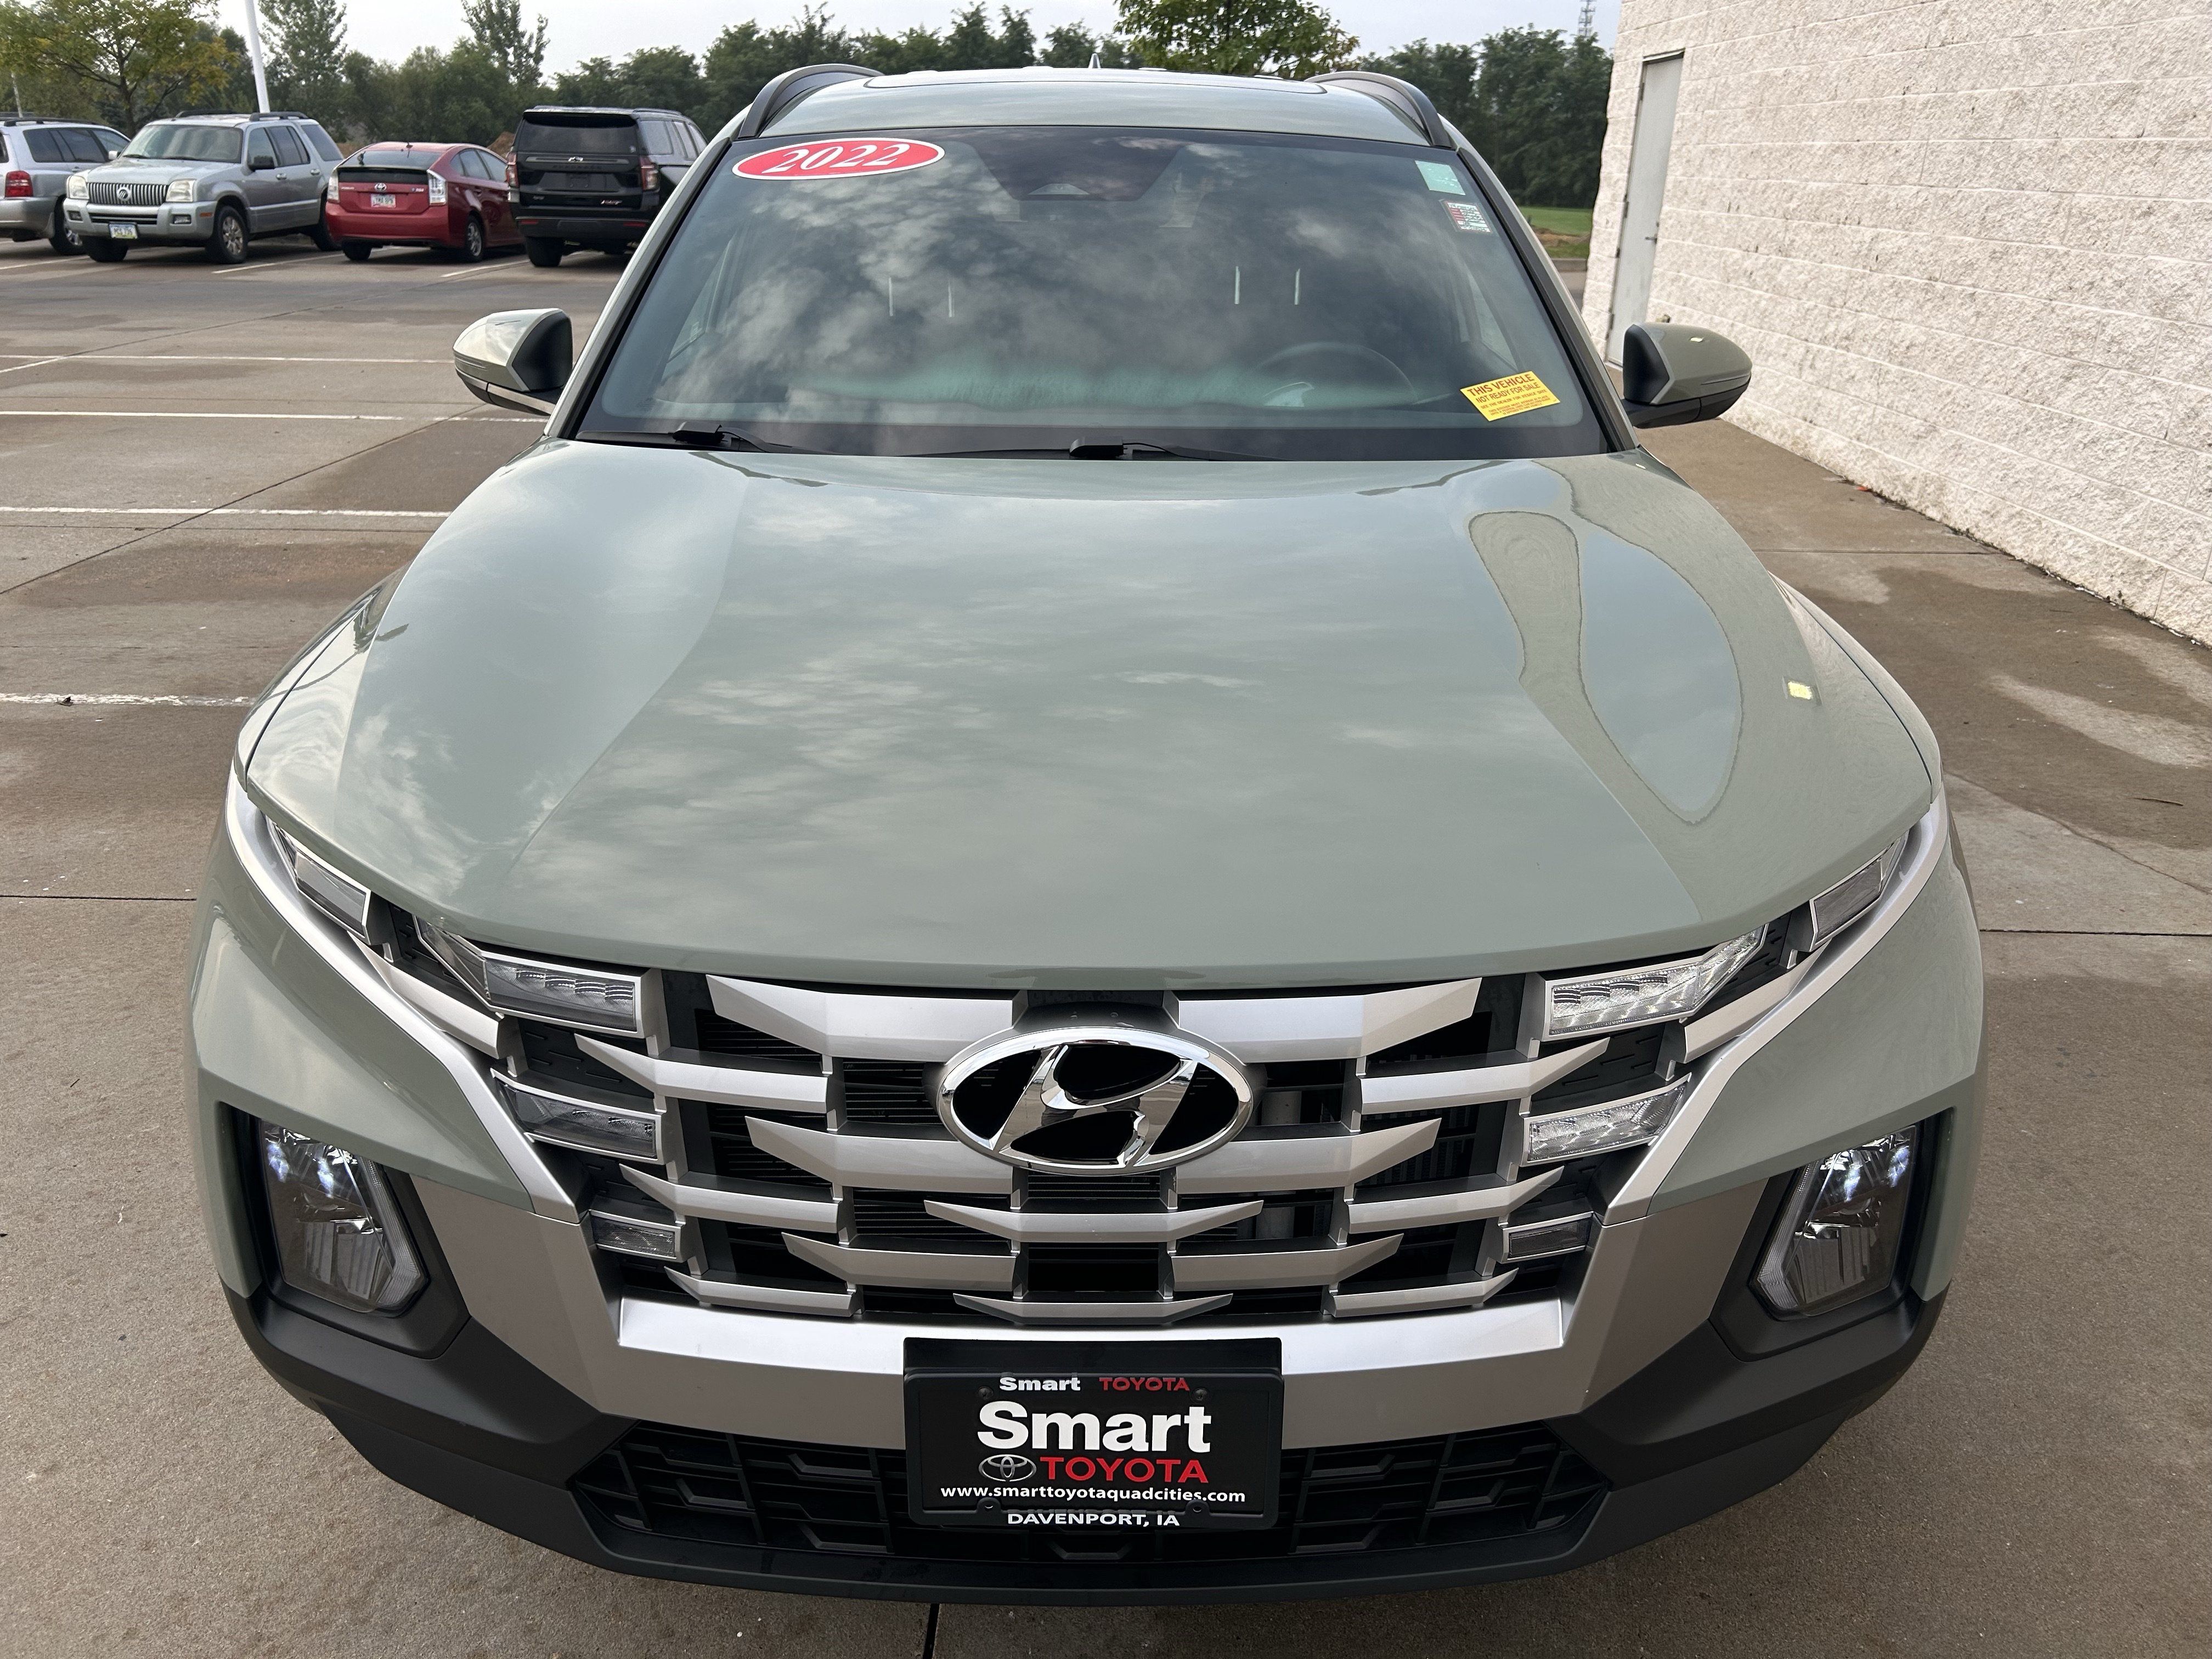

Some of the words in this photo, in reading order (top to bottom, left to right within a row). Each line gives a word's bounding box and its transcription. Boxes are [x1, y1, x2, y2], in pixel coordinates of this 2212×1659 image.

[761, 144, 910, 173] 2022
[1467, 385, 1493, 396] THIS
[1492, 374, 1534, 390] VEHICLE
[1489, 390, 1510, 399] READY
[1522, 382, 1541, 391] SALE
[1000, 1377, 1081, 1391] Smart
[1099, 1378, 1189, 1391] TOYOTA
[977, 1401, 1212, 1453] Smart
[1040, 1457, 1209, 1483] TOYOTA
[940, 1486, 1245, 1502] www.smarttoyotaquadcities.com
[1008, 1514, 1149, 1527] DAVENPORT,
[1156, 1515, 1180, 1526] IA
